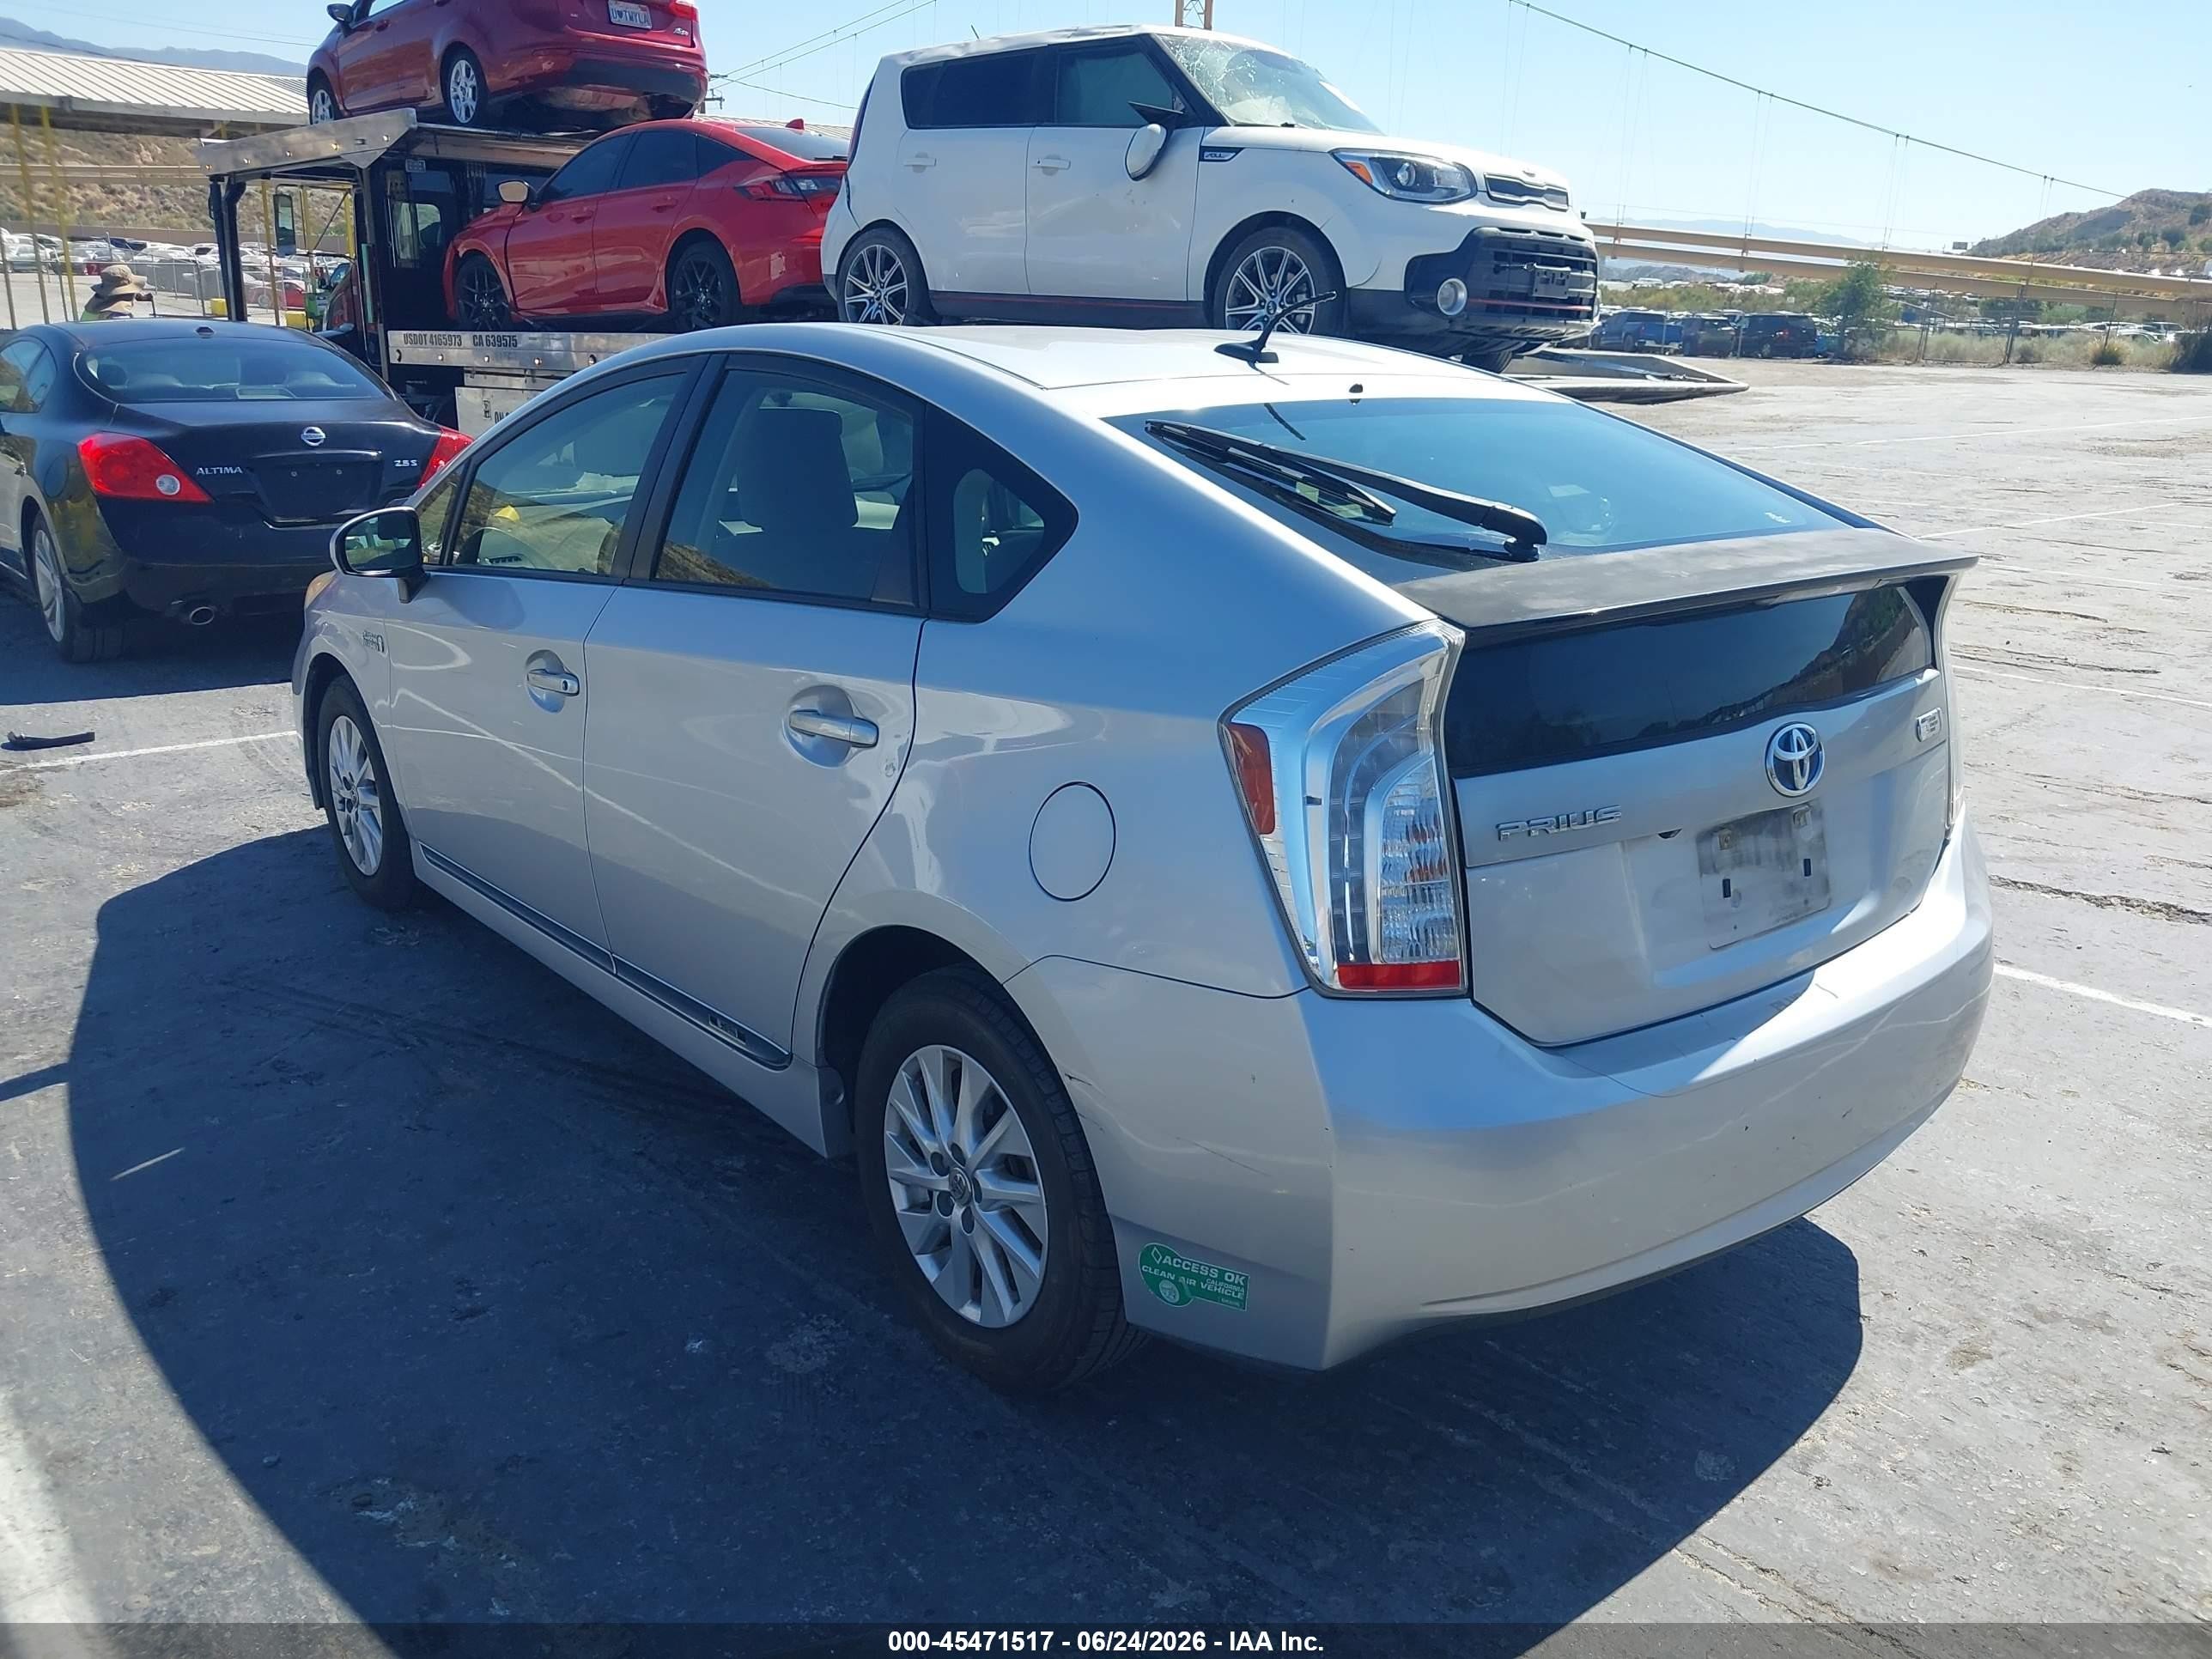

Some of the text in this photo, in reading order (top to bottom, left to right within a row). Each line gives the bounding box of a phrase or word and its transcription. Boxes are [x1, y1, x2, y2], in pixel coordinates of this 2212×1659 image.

[404, 333, 518, 348] USDOT 4165973 CA 639575
[196, 466, 243, 476] ALTIMA
[1496, 805, 1621, 841] PRIUS
[1163, 1255, 1246, 1285] ACCESS OK
[1142, 1265, 1245, 1299] CLEAN AIR VEHICLE
[1206, 1279, 1245, 1293] CALIFORNIA
